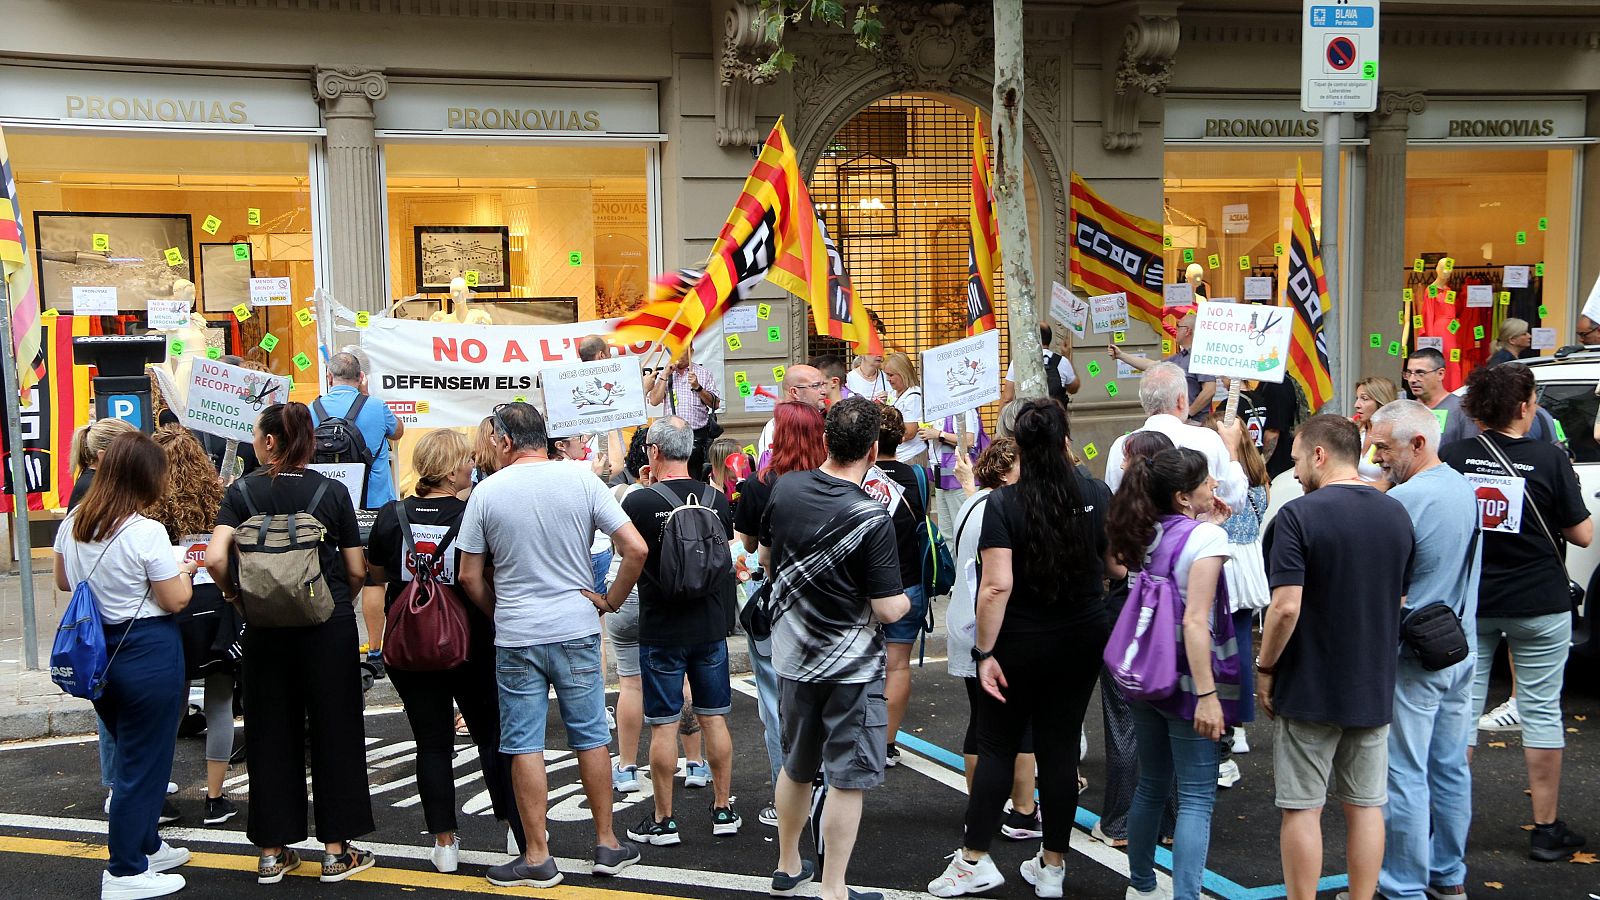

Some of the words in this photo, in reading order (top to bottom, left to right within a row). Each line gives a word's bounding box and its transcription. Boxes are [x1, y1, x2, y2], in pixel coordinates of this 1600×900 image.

[1335, 8, 1358, 19] BLAVA
[65, 95, 248, 124] PRONOVIAS
[447, 107, 601, 131] PRONOVIAS
[1206, 119, 1320, 138] PRONOVIAS
[1448, 119, 1554, 137] PRONOVIAS
[1207, 307, 1224, 317] NO
[1226, 308, 1234, 318] A
[432, 336, 489, 364] NO
[502, 340, 530, 363] A
[1205, 342, 1244, 354] MENOS
[1193, 354, 1258, 369] DERROCHAR
[201, 363, 219, 376] NO
[221, 369, 230, 379] A
[559, 369, 578, 380] NOS
[382, 374, 490, 390] DEFENSEM
[495, 376, 531, 390] ELS
[114, 400, 134, 420] P
[200, 398, 240, 417] MENOS
[385, 403, 414, 413] COO
[188, 408, 253, 433] DERROCHAR
[321, 470, 347, 479] OVIAS
[1468, 476, 1512, 486] PRONOVIAS
[1477, 498, 1507, 517] TOP
[411, 531, 446, 540] RONOVIA
[188, 550, 206, 561] STO
